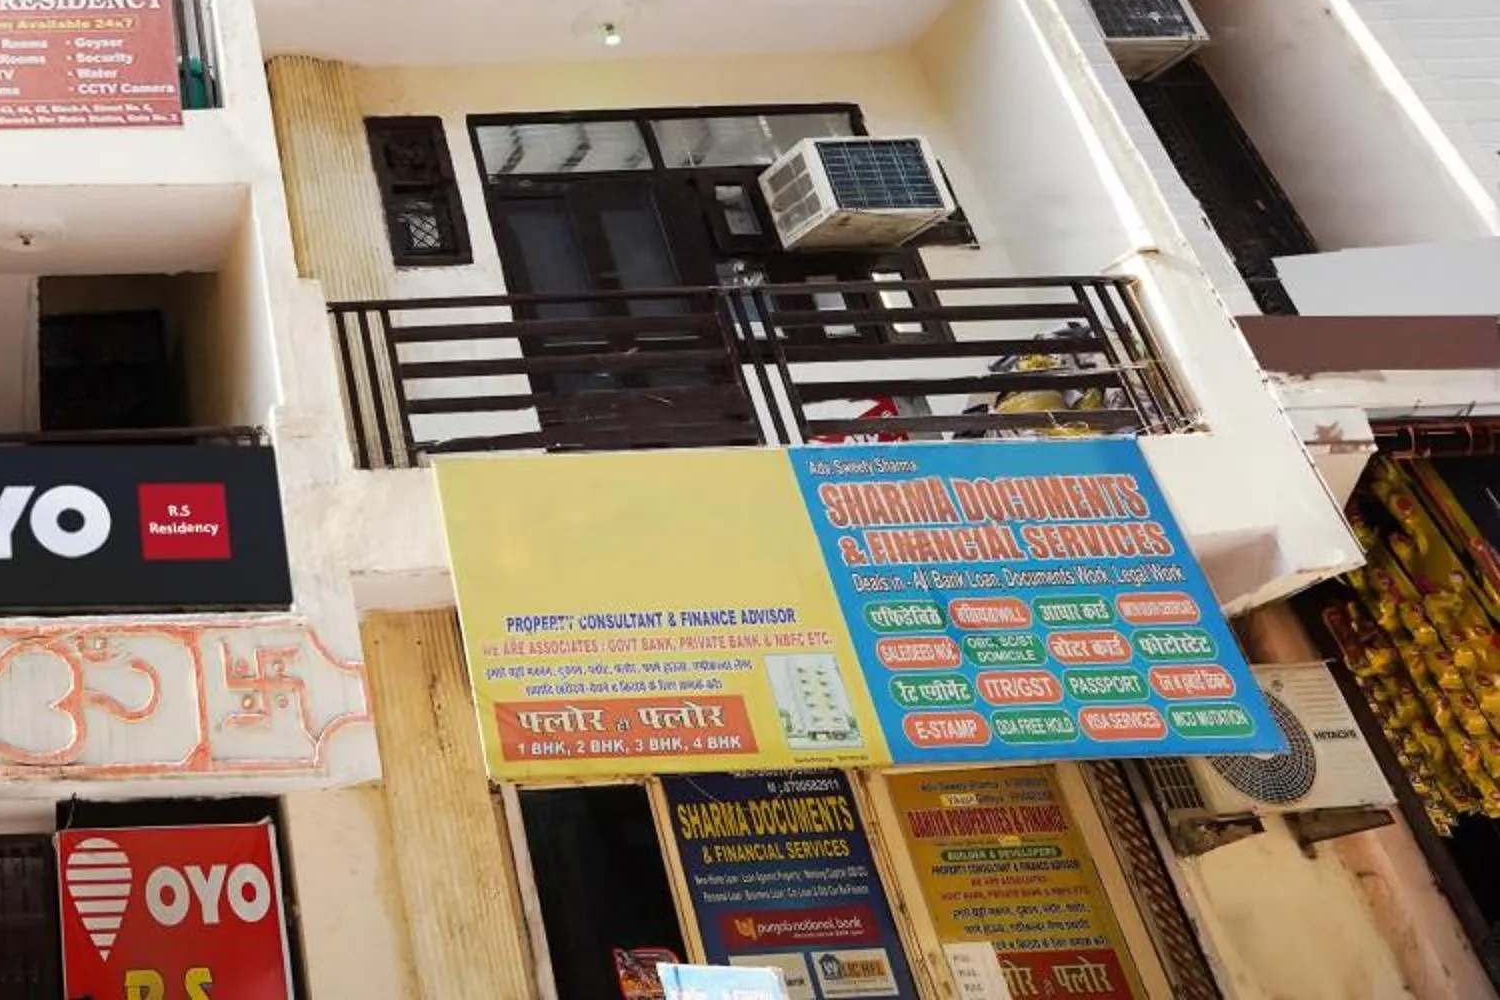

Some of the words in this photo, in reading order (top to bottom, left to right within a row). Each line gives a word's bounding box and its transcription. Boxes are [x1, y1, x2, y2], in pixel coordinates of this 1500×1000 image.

[17, 19, 91, 31] Available
[1, 38, 48, 49] Rooms
[0, 54, 46, 65] Rooms
[75, 52, 133, 65] Security
[76, 68, 117, 79] Water
[78, 83, 118, 94] CCTV
[120, 83, 175, 94] Camera
[818, 475, 963, 529] SHARMA
[949, 473, 1150, 524] DOCUMENTS
[149, 521, 219, 536] Residency
[837, 536, 871, 567] &
[863, 523, 1028, 567] FINANCIAL
[1020, 521, 1175, 560] SERVICES
[851, 573, 891, 592] Deals
[931, 567, 963, 587] Bank
[1001, 567, 1075, 587] Documents
[1112, 564, 1147, 587] Legal
[579, 612, 662, 630] CONSULTANT
[667, 611, 677, 627] &
[681, 610, 737, 627] FINANCE
[741, 608, 796, 625] ADVISOR
[504, 641, 525, 655] ARE
[529, 639, 599, 655] ASSOCIATES
[608, 638, 637, 652] GOVT
[680, 635, 727, 650] PRIVATE
[1138, 633, 1211, 655] फोटोस्टेट
[976, 650, 1036, 662] DOMICILE
[984, 676, 1053, 698] ITR/GST
[1068, 674, 1144, 695] PASSPORT
[916, 719, 978, 740] E-STAMP
[1019, 719, 1047, 735] FREE
[1109, 711, 1161, 729] SERVICES
[518, 742, 526, 756] 1
[531, 740, 572, 757] BHK,
[577, 741, 586, 755] 2
[591, 739, 630, 756] BHK,
[635, 739, 645, 753] 3
[649, 737, 690, 752] BHK,
[692, 736, 704, 750] 4
[707, 735, 741, 750] BHK
[677, 801, 751, 839] SHARMA
[750, 796, 854, 836] DOCUMENTS
[702, 846, 713, 864] &
[716, 843, 785, 863] FINANCIAL
[785, 839, 850, 860] SERVICES
[145, 863, 270, 926] OYO
[835, 916, 863, 930] bank
